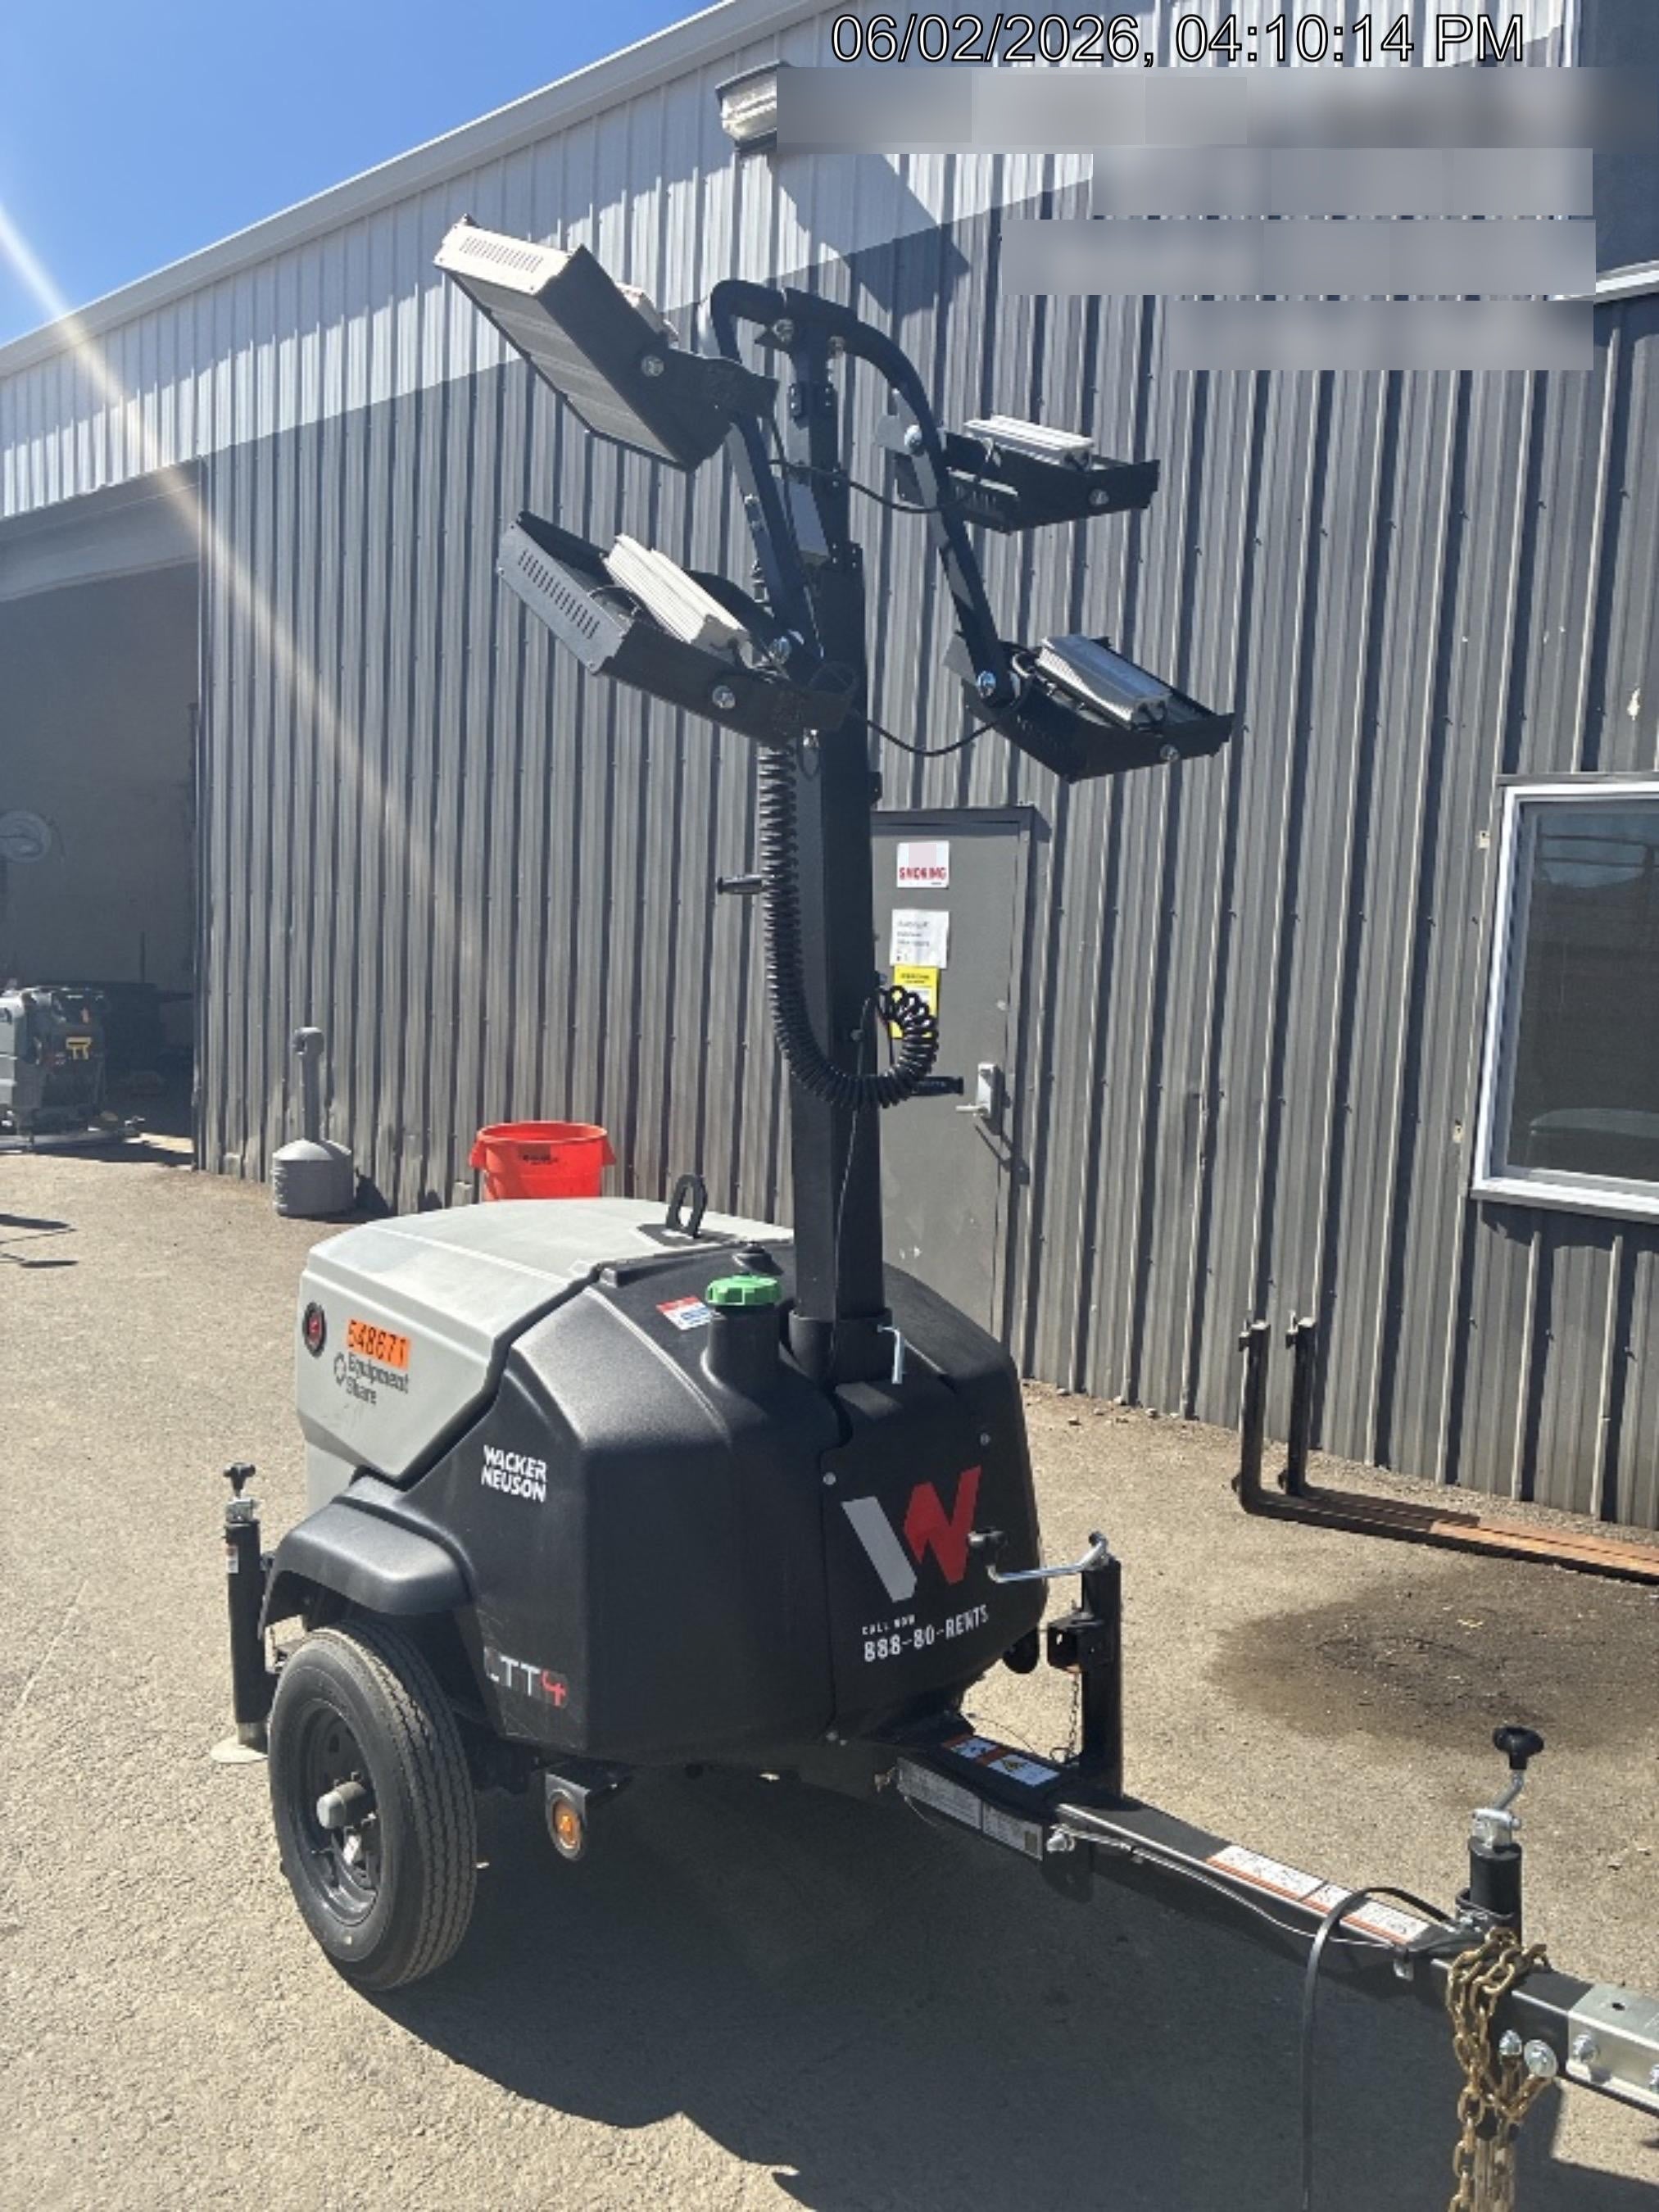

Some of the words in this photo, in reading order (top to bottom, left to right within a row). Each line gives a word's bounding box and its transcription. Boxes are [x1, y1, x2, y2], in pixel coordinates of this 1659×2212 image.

[348, 1353, 409, 1394] Equipment
[483, 1444, 546, 1483] WACKER
[481, 1465, 546, 1503] NEUSON
[863, 1603, 989, 1662] 888-80-RENTS
